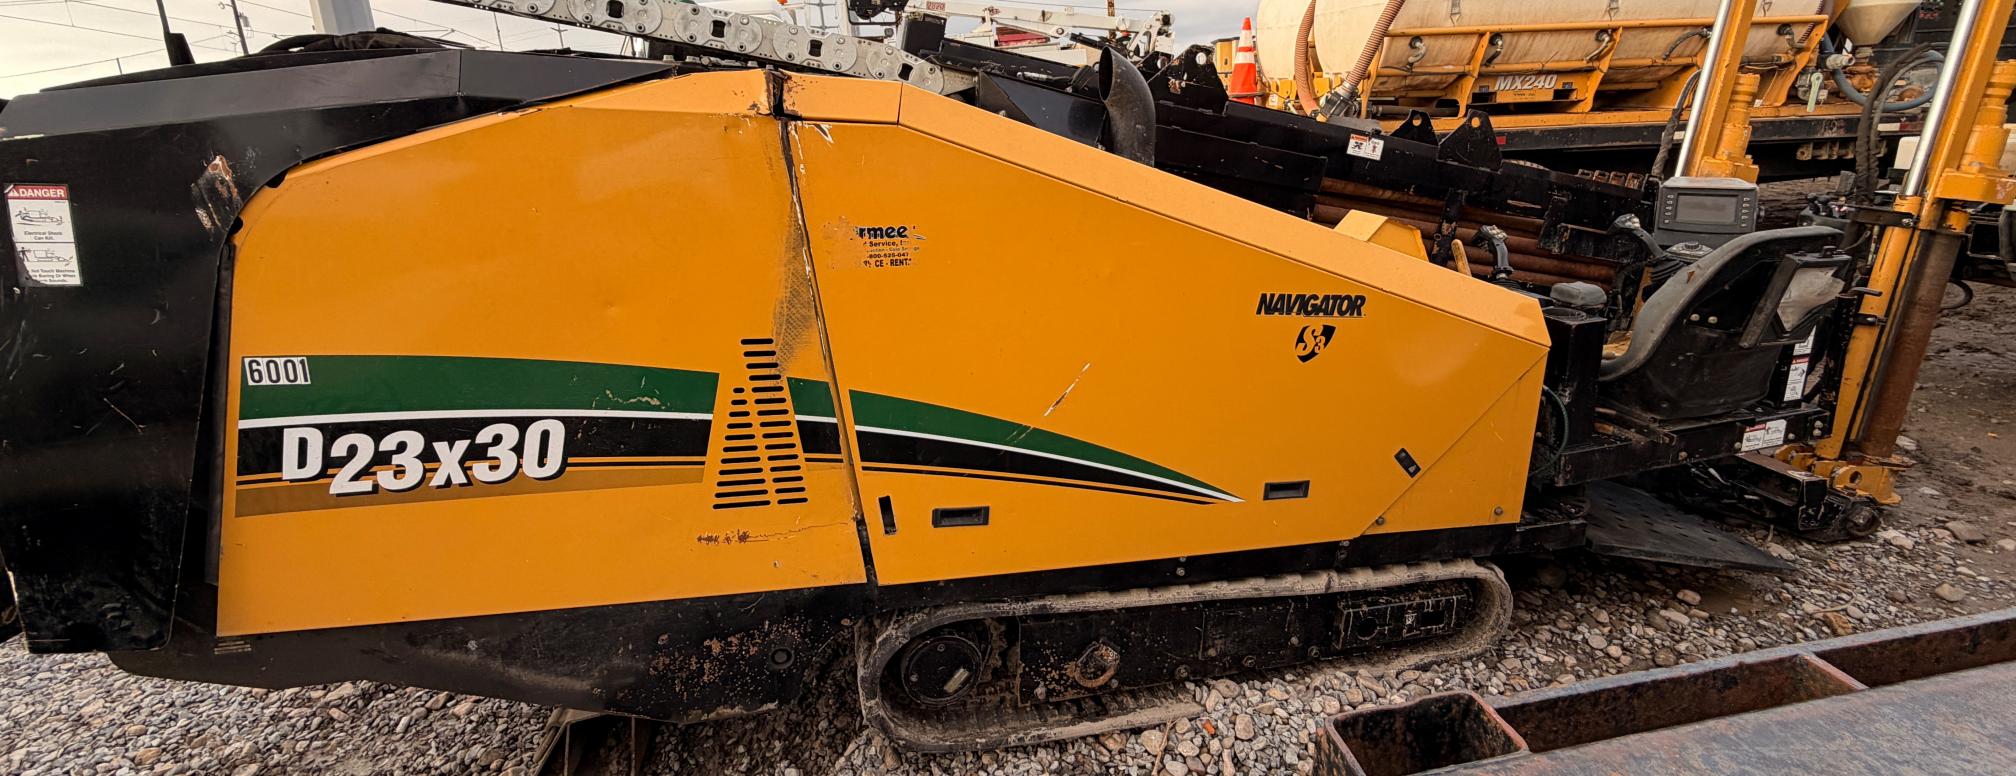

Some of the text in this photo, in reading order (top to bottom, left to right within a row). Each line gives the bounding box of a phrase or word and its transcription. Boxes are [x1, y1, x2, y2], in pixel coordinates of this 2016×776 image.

[1494, 74, 1558, 91] MX240
[19, 189, 65, 198] DANGER
[857, 226, 909, 239] rmee
[1256, 293, 1366, 317] NAVIGATOR
[247, 358, 310, 385] 6001
[281, 418, 567, 496] D23x30
